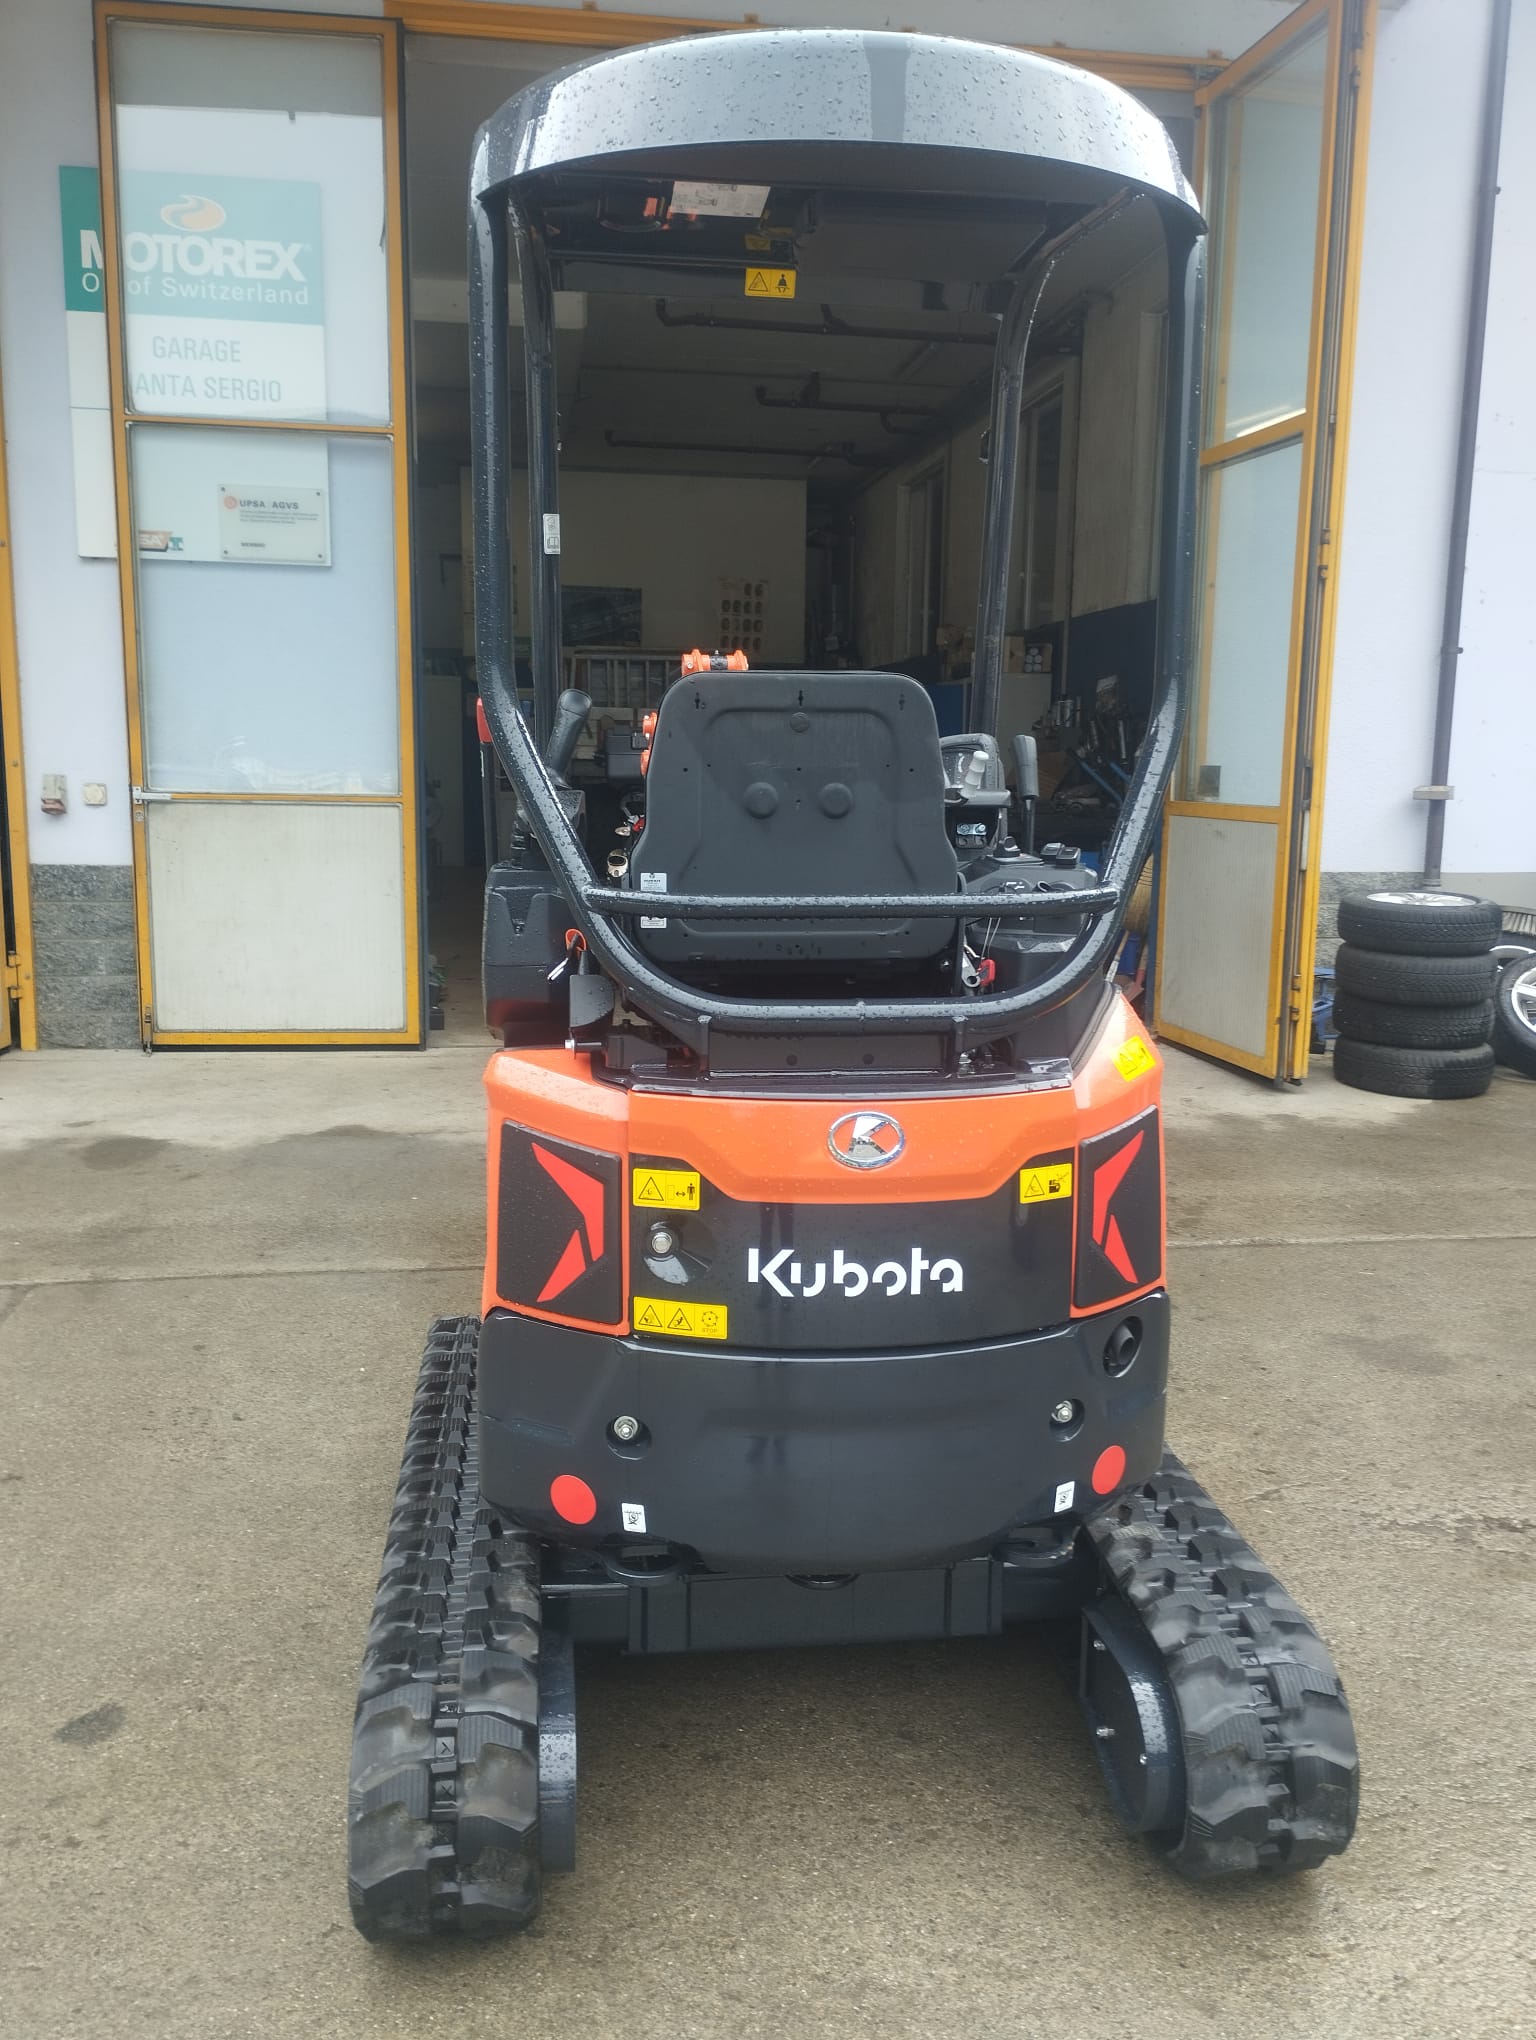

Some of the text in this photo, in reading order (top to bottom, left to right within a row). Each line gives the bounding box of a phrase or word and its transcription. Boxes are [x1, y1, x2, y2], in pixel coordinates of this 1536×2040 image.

[80, 229, 307, 283] MOTOREX
[127, 276, 153, 295] of
[161, 277, 309, 305] Switzerland
[152, 335, 242, 363] GARAGE
[134, 372, 282, 402] ANTA SERGIO
[239, 500, 299, 511] UPSA AGVS
[747, 1247, 964, 1298] Kubota
